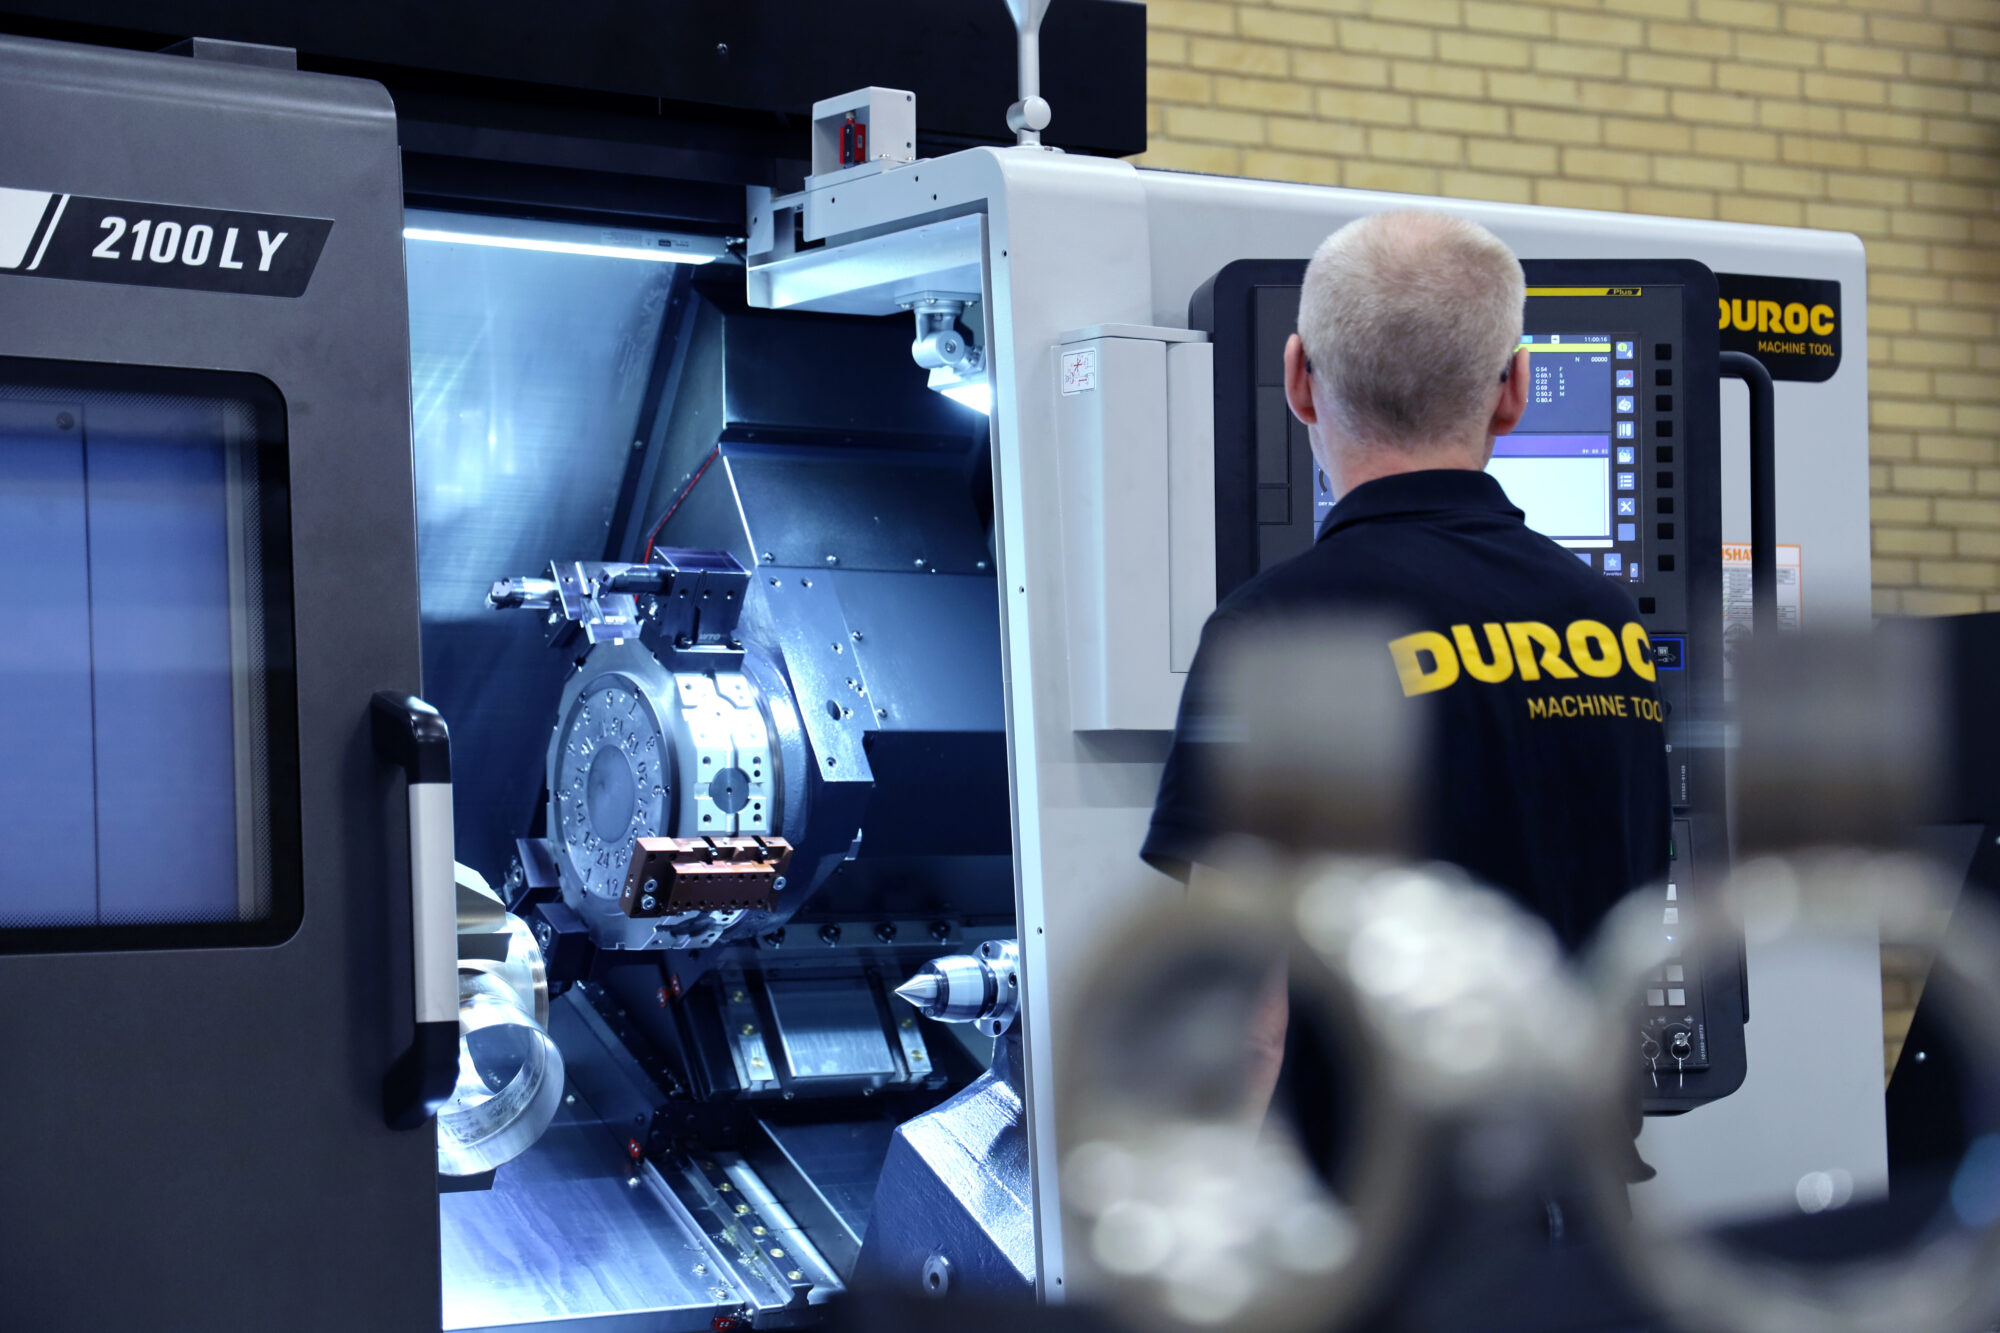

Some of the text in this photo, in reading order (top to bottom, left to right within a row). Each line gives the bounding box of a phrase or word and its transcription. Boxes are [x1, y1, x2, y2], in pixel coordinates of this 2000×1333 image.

[92, 216, 213, 266] 2100
[1613, 288, 1633, 296] Plus
[1758, 340, 1835, 356] MACHINE TOOL
[1721, 547, 1752, 561] SHA
[1388, 619, 1656, 697] DUROC
[1527, 695, 1627, 720] MACHINE
[596, 848, 610, 869] 24
[606, 877, 619, 897] 12
